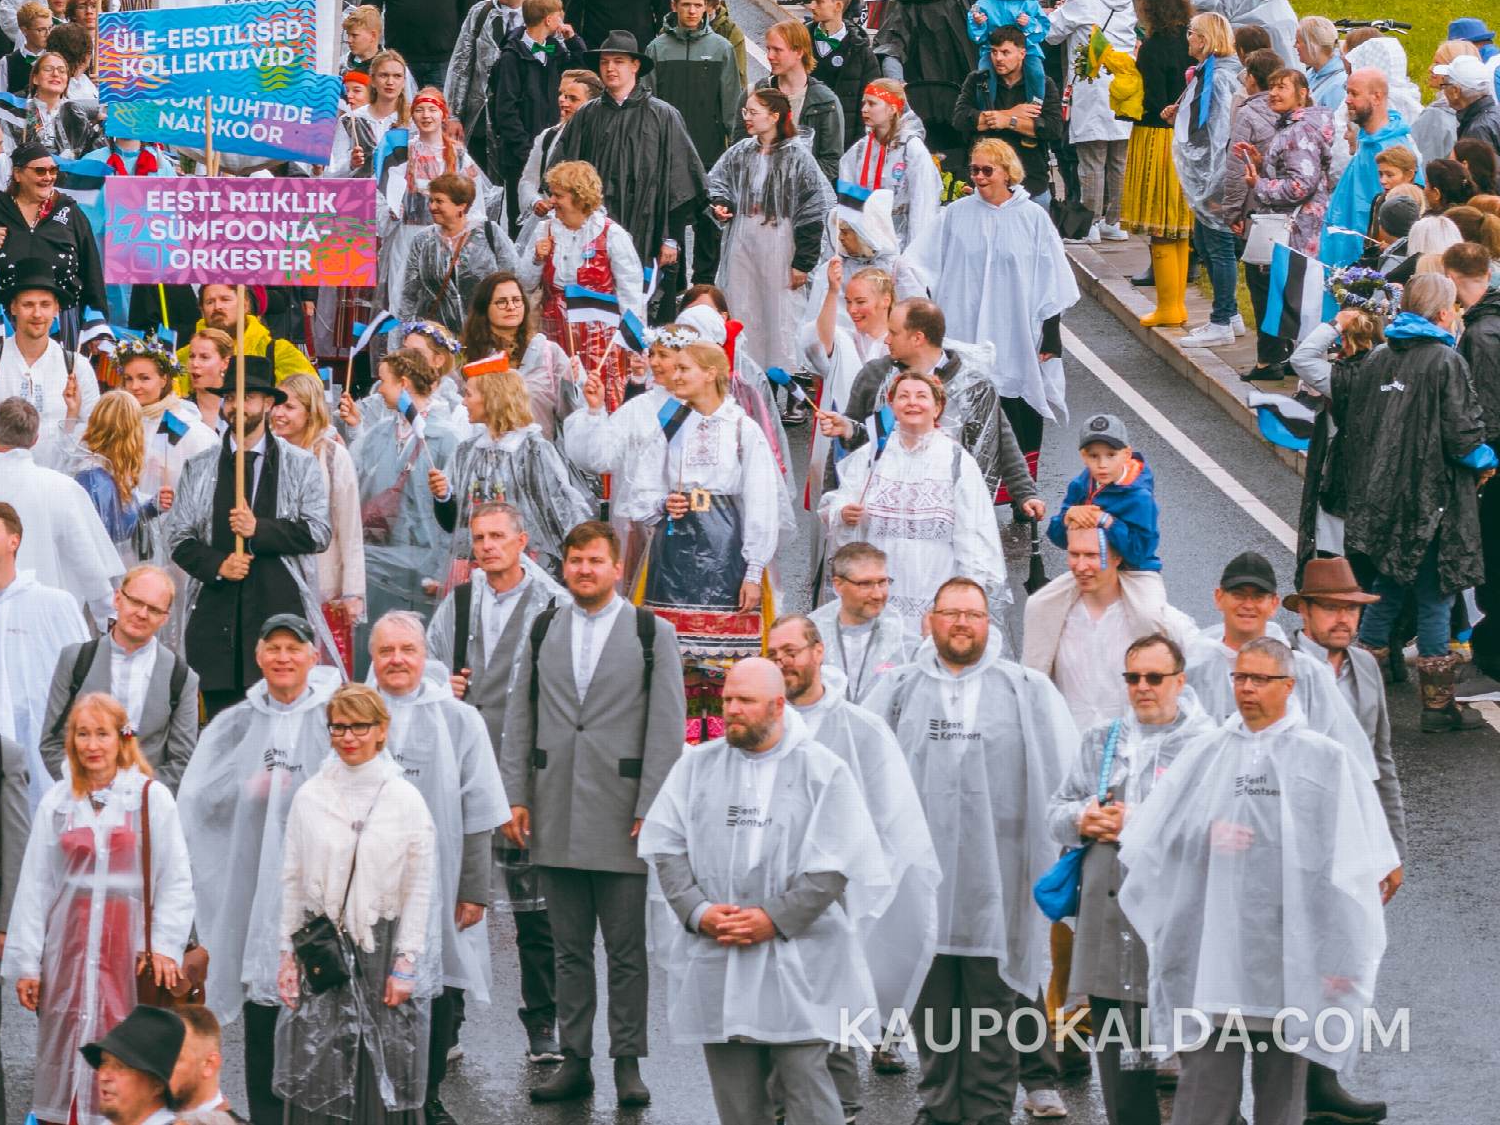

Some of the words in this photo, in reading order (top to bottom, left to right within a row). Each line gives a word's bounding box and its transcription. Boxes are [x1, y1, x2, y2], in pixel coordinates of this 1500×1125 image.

[113, 20, 302, 53] ÜLE-EESTILISED
[121, 46, 295, 78] KOLLEKTIIVID
[146, 190, 221, 213] EESTI
[229, 191, 337, 214] RIIKLIK
[149, 214, 332, 242] SÜMFOONIA-
[169, 248, 313, 271] ORKESTER
